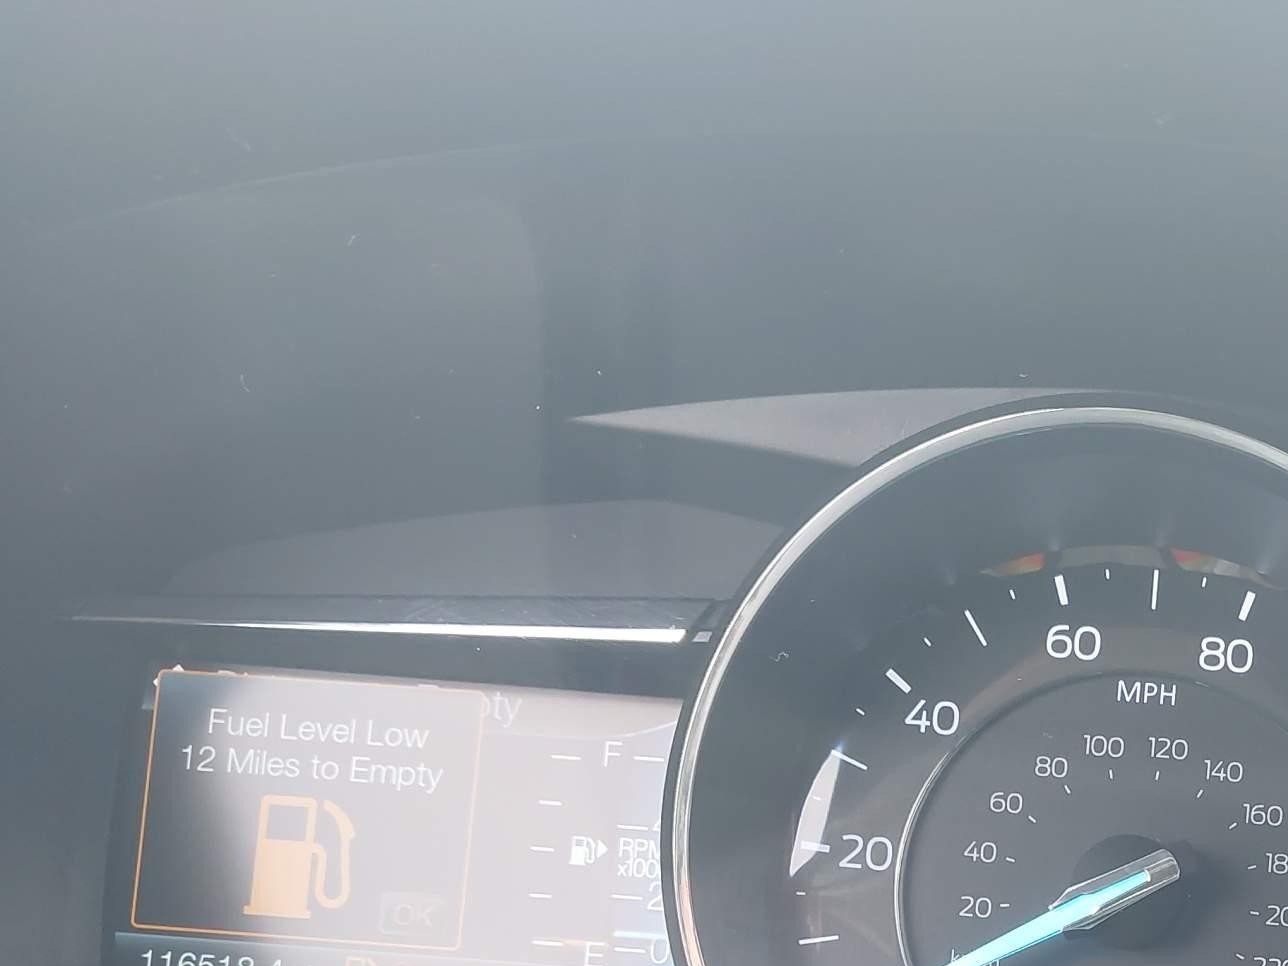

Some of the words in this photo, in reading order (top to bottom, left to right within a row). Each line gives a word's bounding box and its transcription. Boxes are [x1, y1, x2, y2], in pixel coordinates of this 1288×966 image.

[1045, 625, 1101, 662] 60
[1199, 637, 1254, 674] 80
[1116, 679, 1177, 707] MPH
[207, 708, 270, 738] Fuel
[280, 714, 357, 744] Level
[367, 718, 429, 748] Low
[905, 701, 960, 736] 40
[603, 740, 624, 767] F
[1083, 733, 1125, 758] 100
[1148, 735, 1189, 761] 120
[181, 744, 216, 772] 12
[226, 748, 301, 779] Miles
[311, 753, 340, 782] to
[349, 757, 443, 793] Empty
[1034, 756, 1069, 781] 80
[1203, 758, 1244, 784] 140
[989, 791, 1024, 816] 60
[1242, 803, 1284, 828] 160
[839, 834, 893, 870] 20
[963, 839, 997, 864] 40
[391, 904, 435, 928] OK
[958, 895, 993, 919] 20
